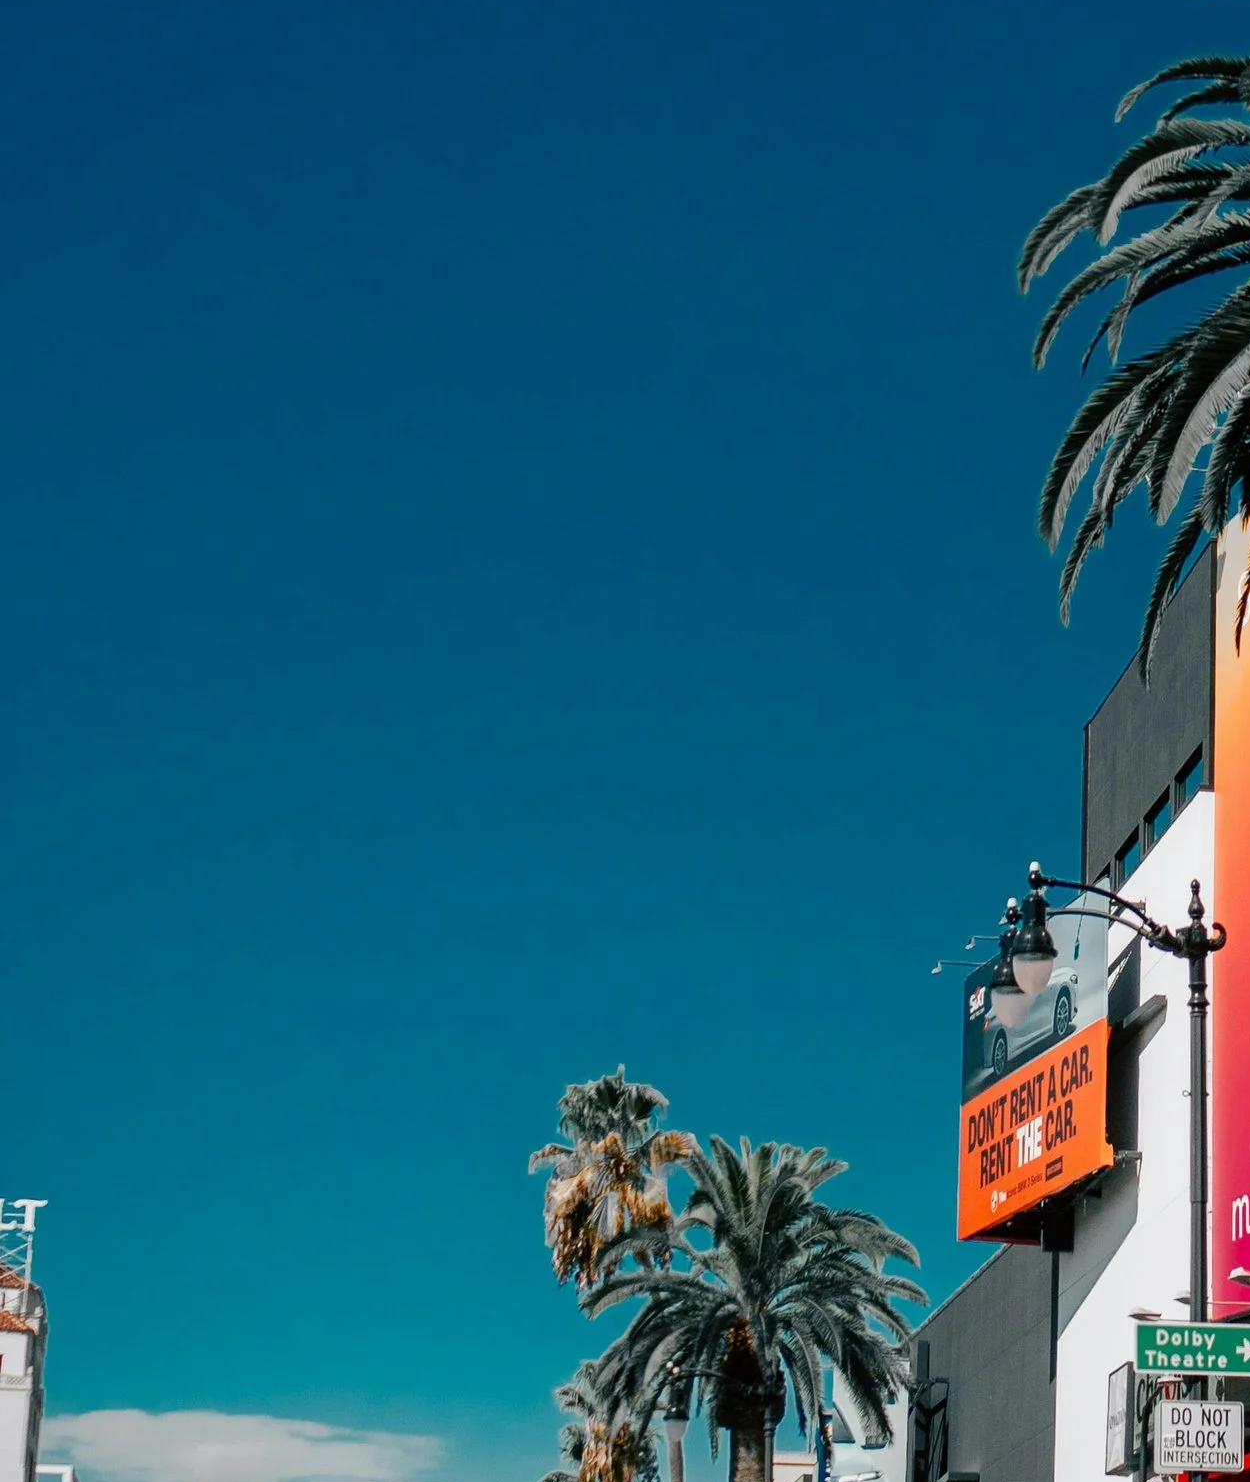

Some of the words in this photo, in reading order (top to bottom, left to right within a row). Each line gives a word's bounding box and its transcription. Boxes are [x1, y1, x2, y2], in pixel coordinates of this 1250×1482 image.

[1009, 1071, 1045, 1126] RENT
[1047, 1064, 1057, 1107] A
[1060, 1044, 1093, 1093] CAR.
[980, 1133, 1014, 1189] RENT
[1016, 1115, 1043, 1168] THE
[1045, 1099, 1077, 1151] CAR.
[1156, 1328, 1216, 1350] Dolby
[1145, 1350, 1228, 1369] Theatre
[1171, 1407, 1192, 1426] DO
[1201, 1408, 1232, 1427] NOT
[1175, 1430, 1227, 1449] BLOCK
[1163, 1450, 1239, 1465] INTERSECTION
